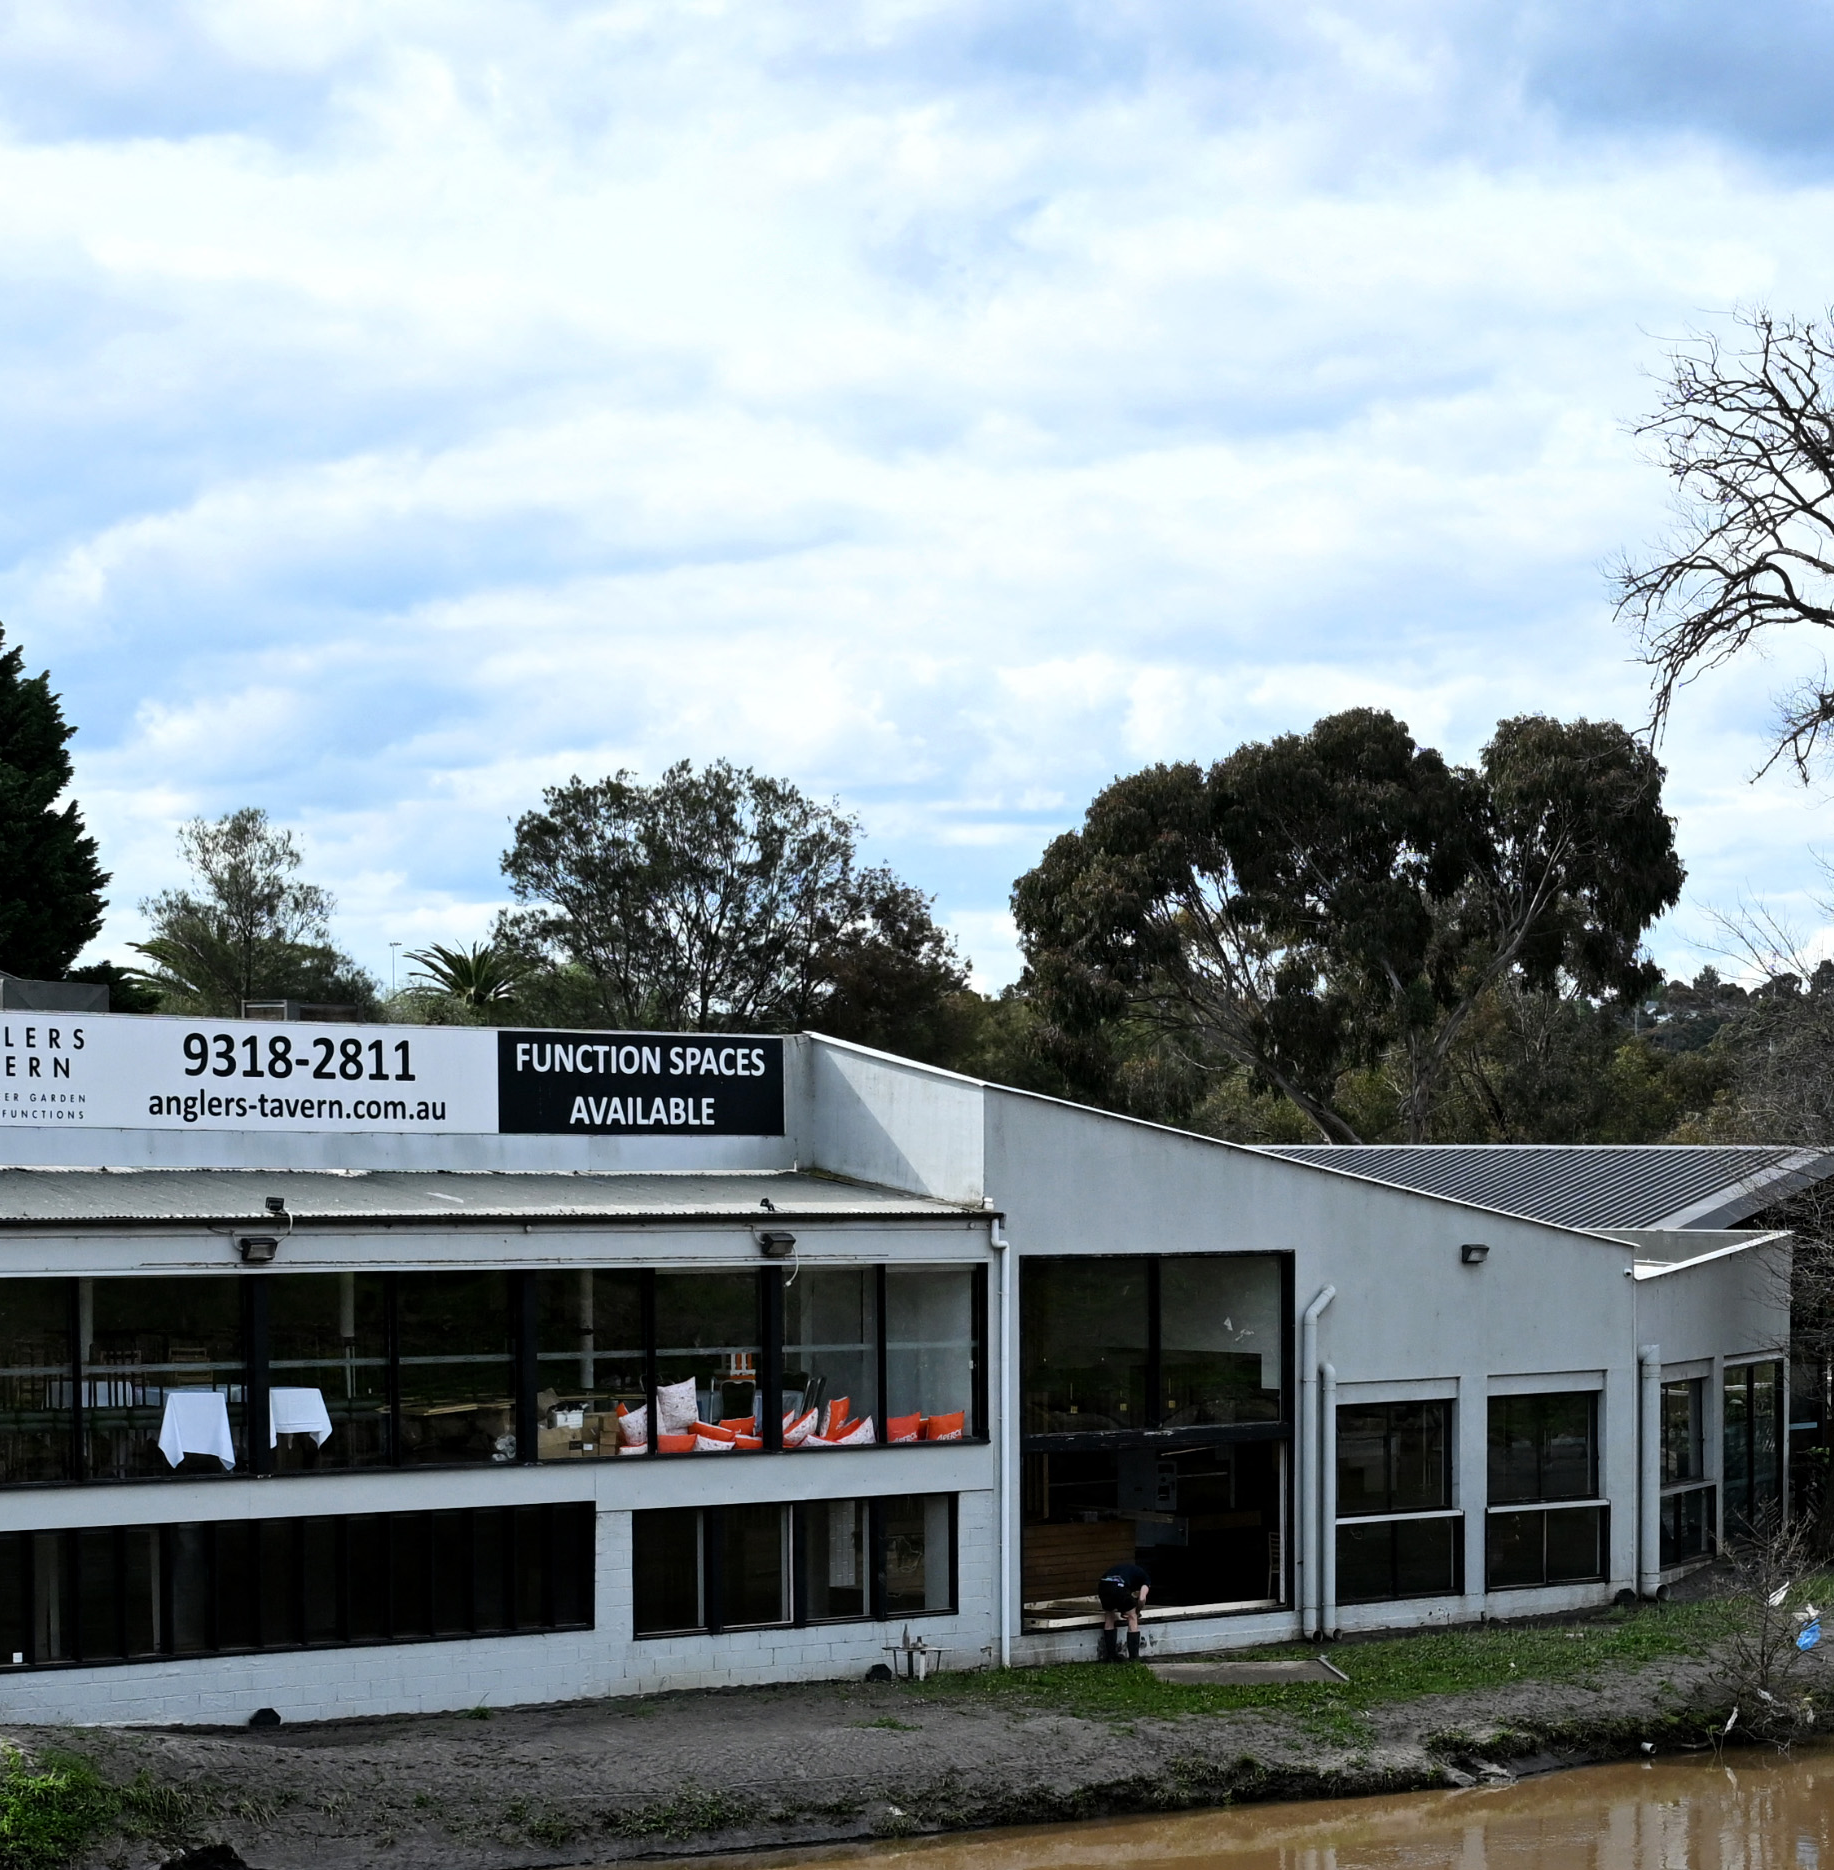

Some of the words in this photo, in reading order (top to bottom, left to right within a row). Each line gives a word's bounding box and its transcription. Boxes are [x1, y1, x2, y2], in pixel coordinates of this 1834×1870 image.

[182, 1031, 416, 1082] 9318-2811
[517, 1043, 661, 1075] FUNCTION
[669, 1046, 765, 1077] SPACES
[30, 1093, 86, 1103] GARDEN
[148, 1087, 446, 1125] anglers-tavern.com.au
[569, 1096, 716, 1126] AVAILABLE
[2, 1109, 85, 1120] FUNCTIONS
